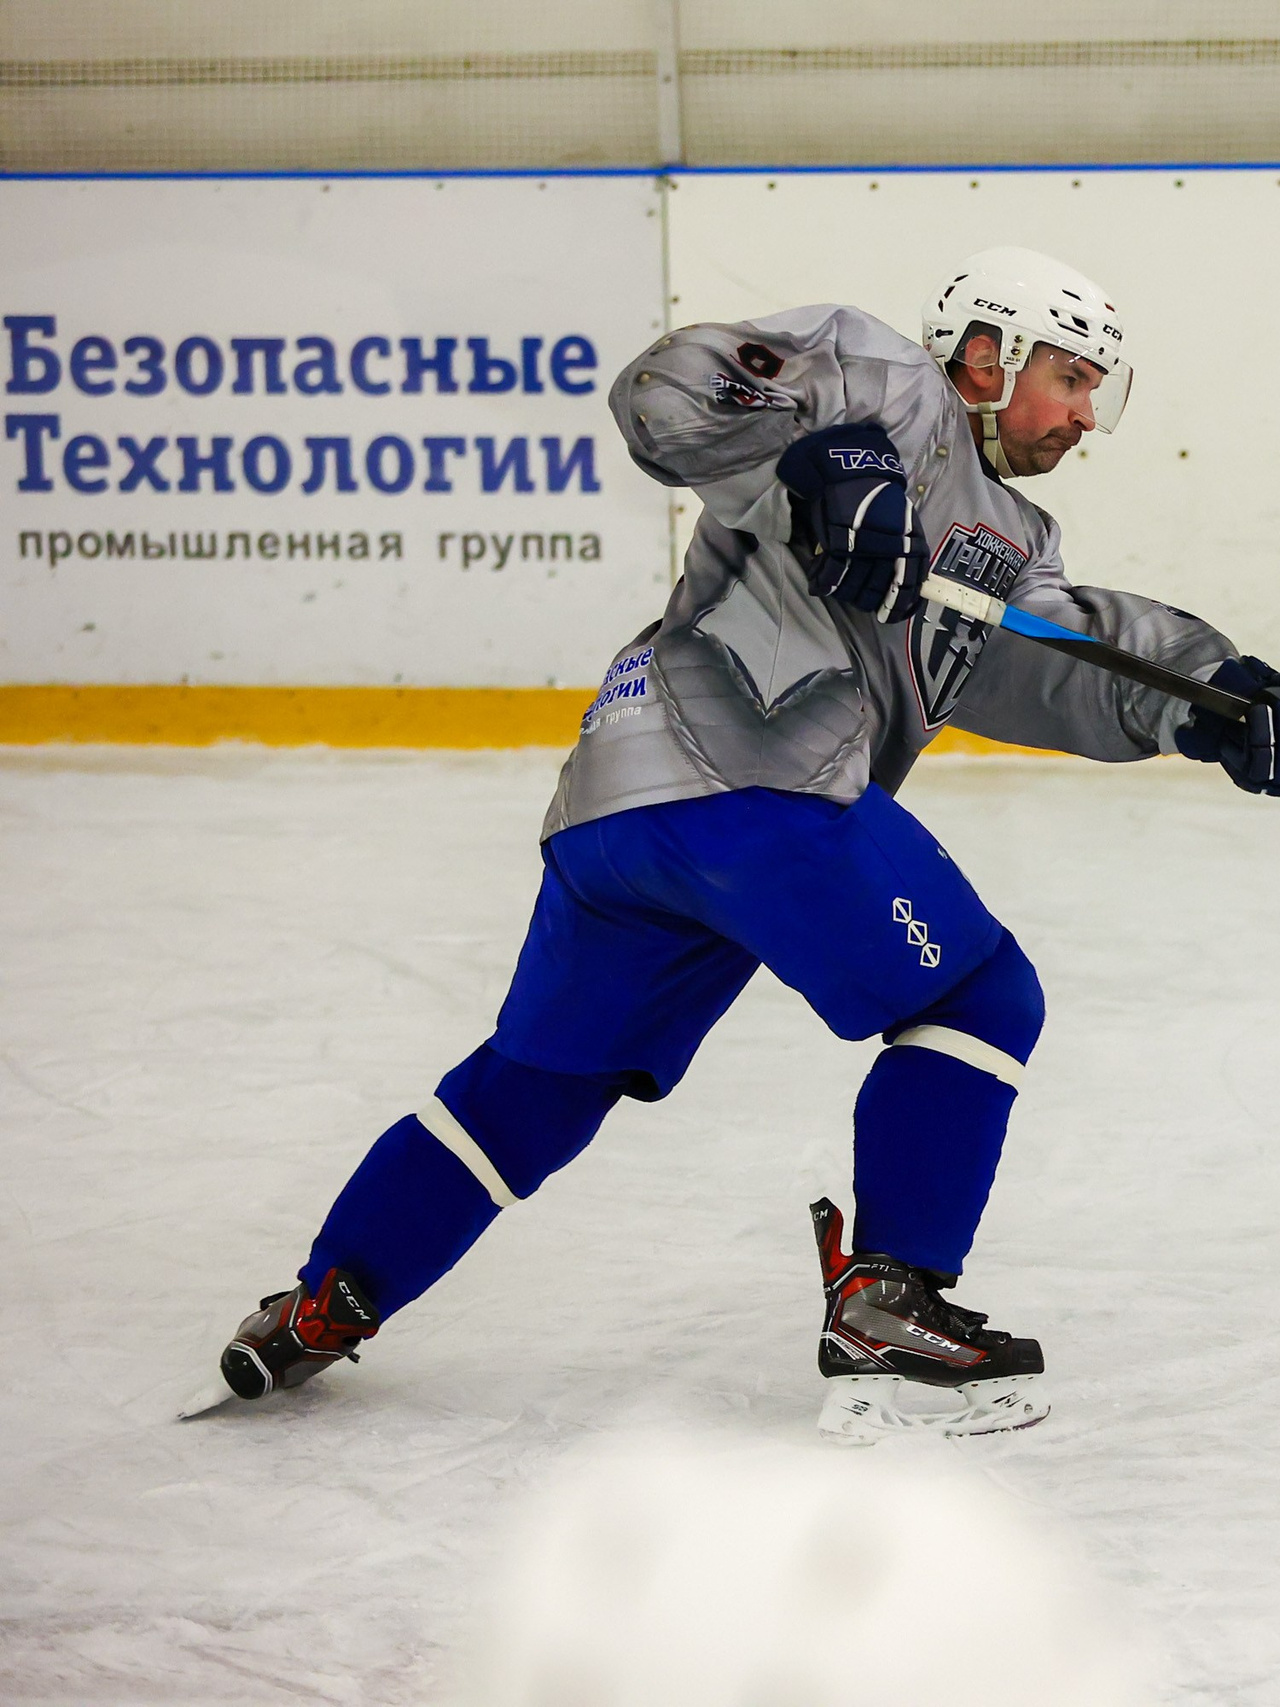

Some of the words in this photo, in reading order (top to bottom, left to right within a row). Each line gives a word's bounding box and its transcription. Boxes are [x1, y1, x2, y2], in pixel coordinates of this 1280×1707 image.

[973, 298, 1017, 317] CCM
[3, 314, 598, 396] Безопасные
[5, 413, 602, 494] Технологии
[19, 529, 403, 567] промышленная
[438, 529, 602, 569] группа
[606, 706, 642, 725] группа
[813, 1208, 829, 1221] CM
[338, 1281, 372, 1320] CCM
[905, 1323, 962, 1352] CCM
